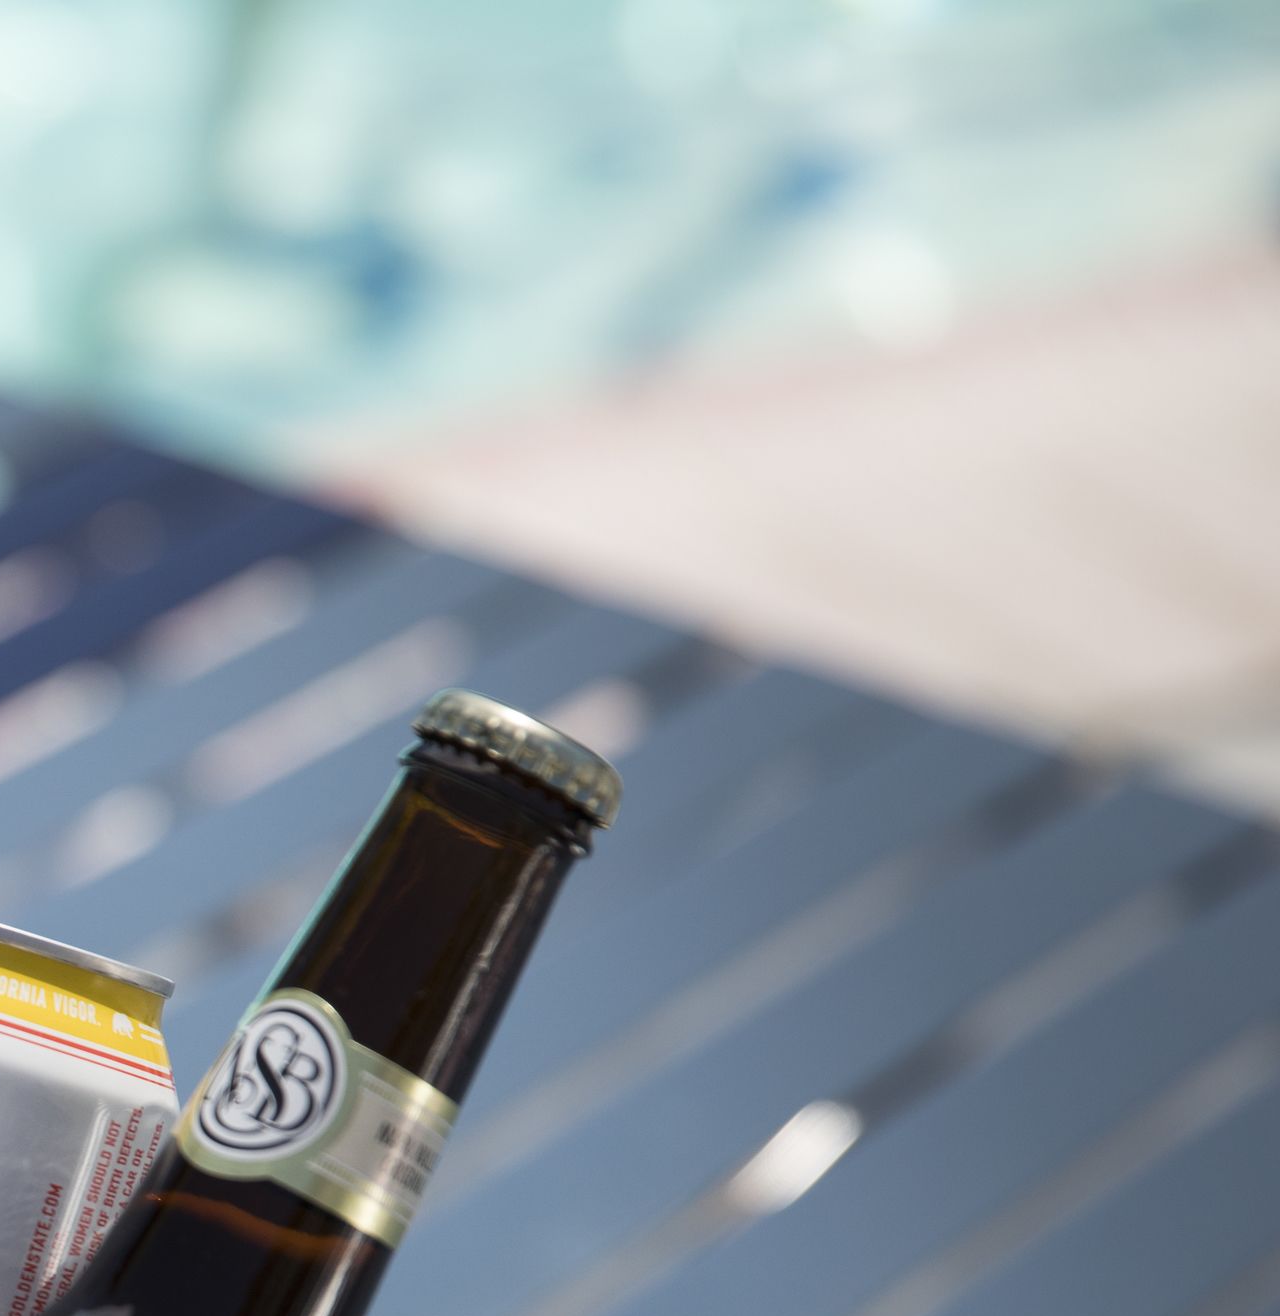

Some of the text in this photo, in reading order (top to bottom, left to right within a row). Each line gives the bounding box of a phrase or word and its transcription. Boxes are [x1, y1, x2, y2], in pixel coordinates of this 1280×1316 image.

[51, 991, 103, 1028] VIGOR.
[116, 1104, 146, 1167] DEFECTS.
[102, 1167, 125, 1208] BIRTH
[122, 1169, 139, 1198] CAR
[132, 1147, 146, 1169] OR
[54, 1118, 122, 1302] ERAL. WOMEN SHOULD NOT
[96, 1208, 111, 1229] OF
